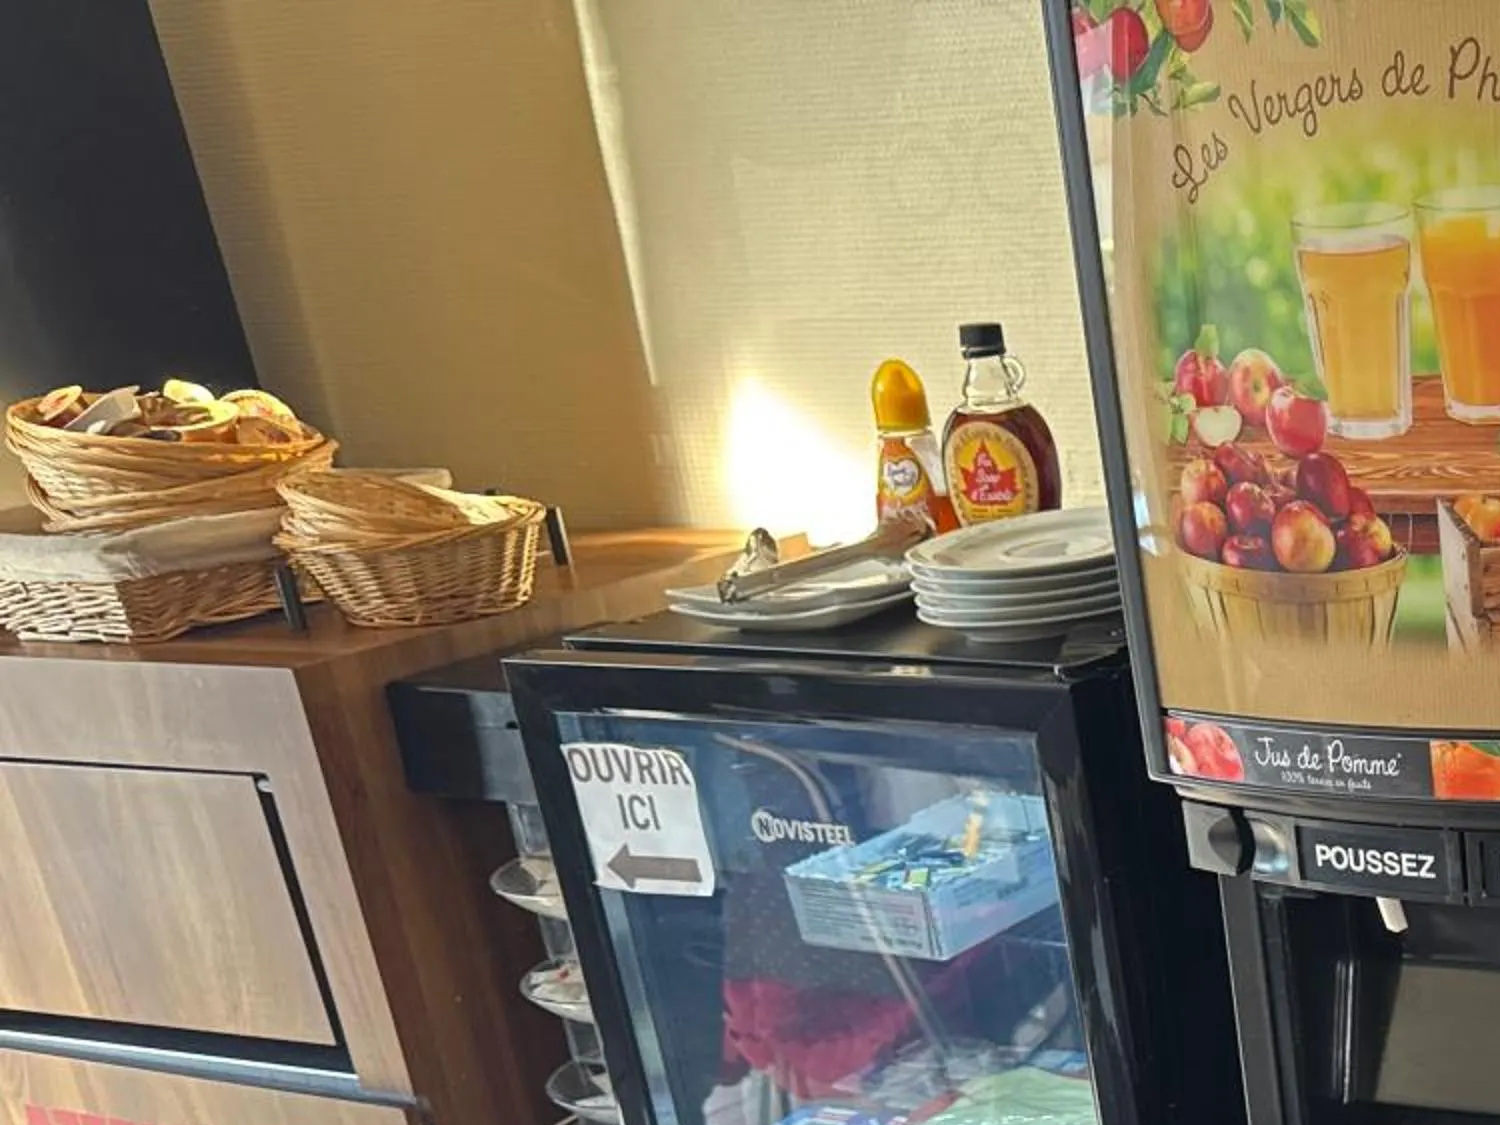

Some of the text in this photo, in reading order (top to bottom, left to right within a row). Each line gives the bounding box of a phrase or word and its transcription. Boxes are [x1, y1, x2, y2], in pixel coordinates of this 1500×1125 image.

[1172, 133, 1229, 203] Les
[1228, 65, 1364, 137] Vergers
[1381, 50, 1430, 99] de
[568, 745, 691, 787] OUVRIR
[1254, 736, 1291, 767] Jus
[1297, 745, 1323, 770] de
[618, 794, 662, 832] ICI
[1315, 844, 1436, 879] POUSSEZ
